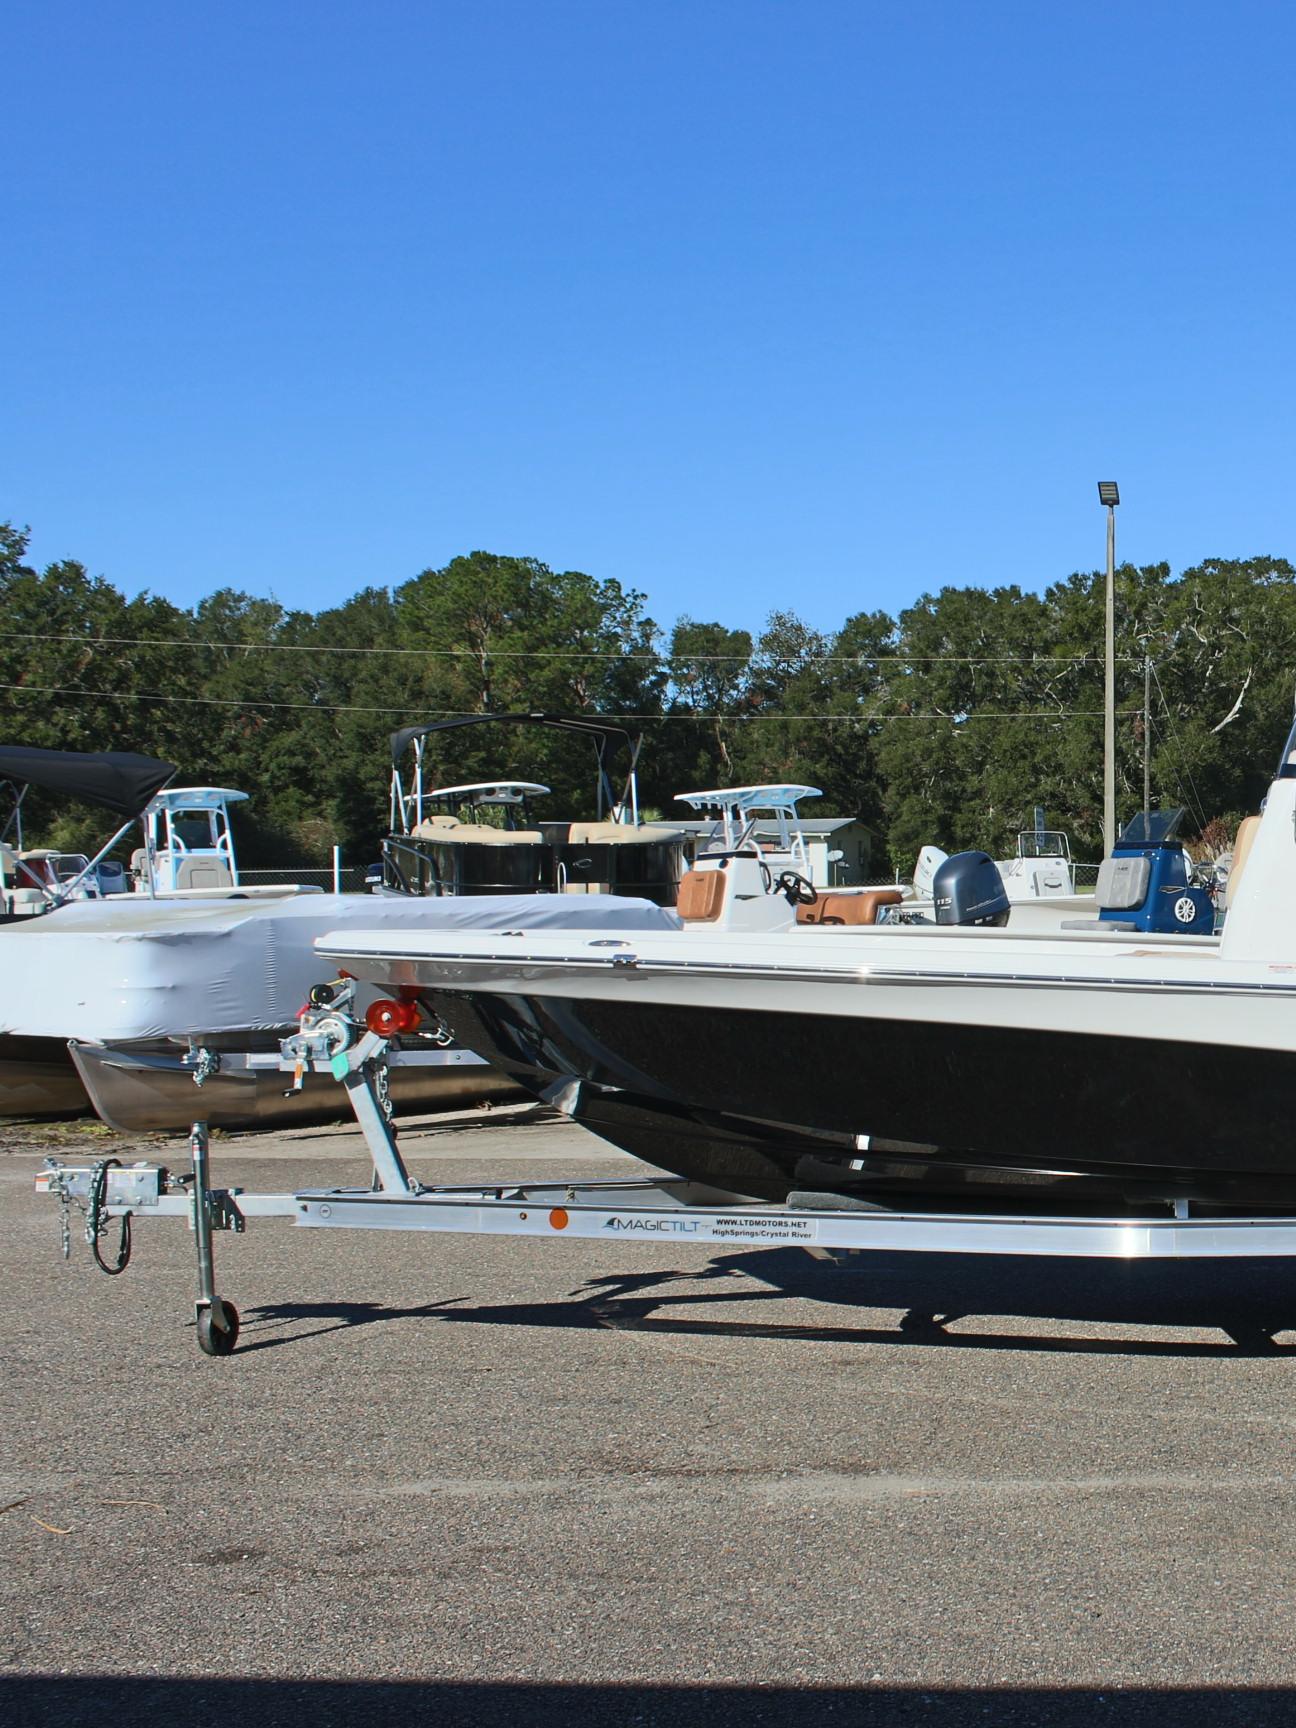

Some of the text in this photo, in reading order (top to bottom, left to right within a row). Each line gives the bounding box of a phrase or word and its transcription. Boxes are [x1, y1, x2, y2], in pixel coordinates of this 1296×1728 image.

[937, 897, 952, 905] 115
[617, 1219, 700, 1232] MAGICTILT
[716, 1219, 808, 1229] WWW.LTDMOTORS.NET
[791, 1230, 812, 1238] River
